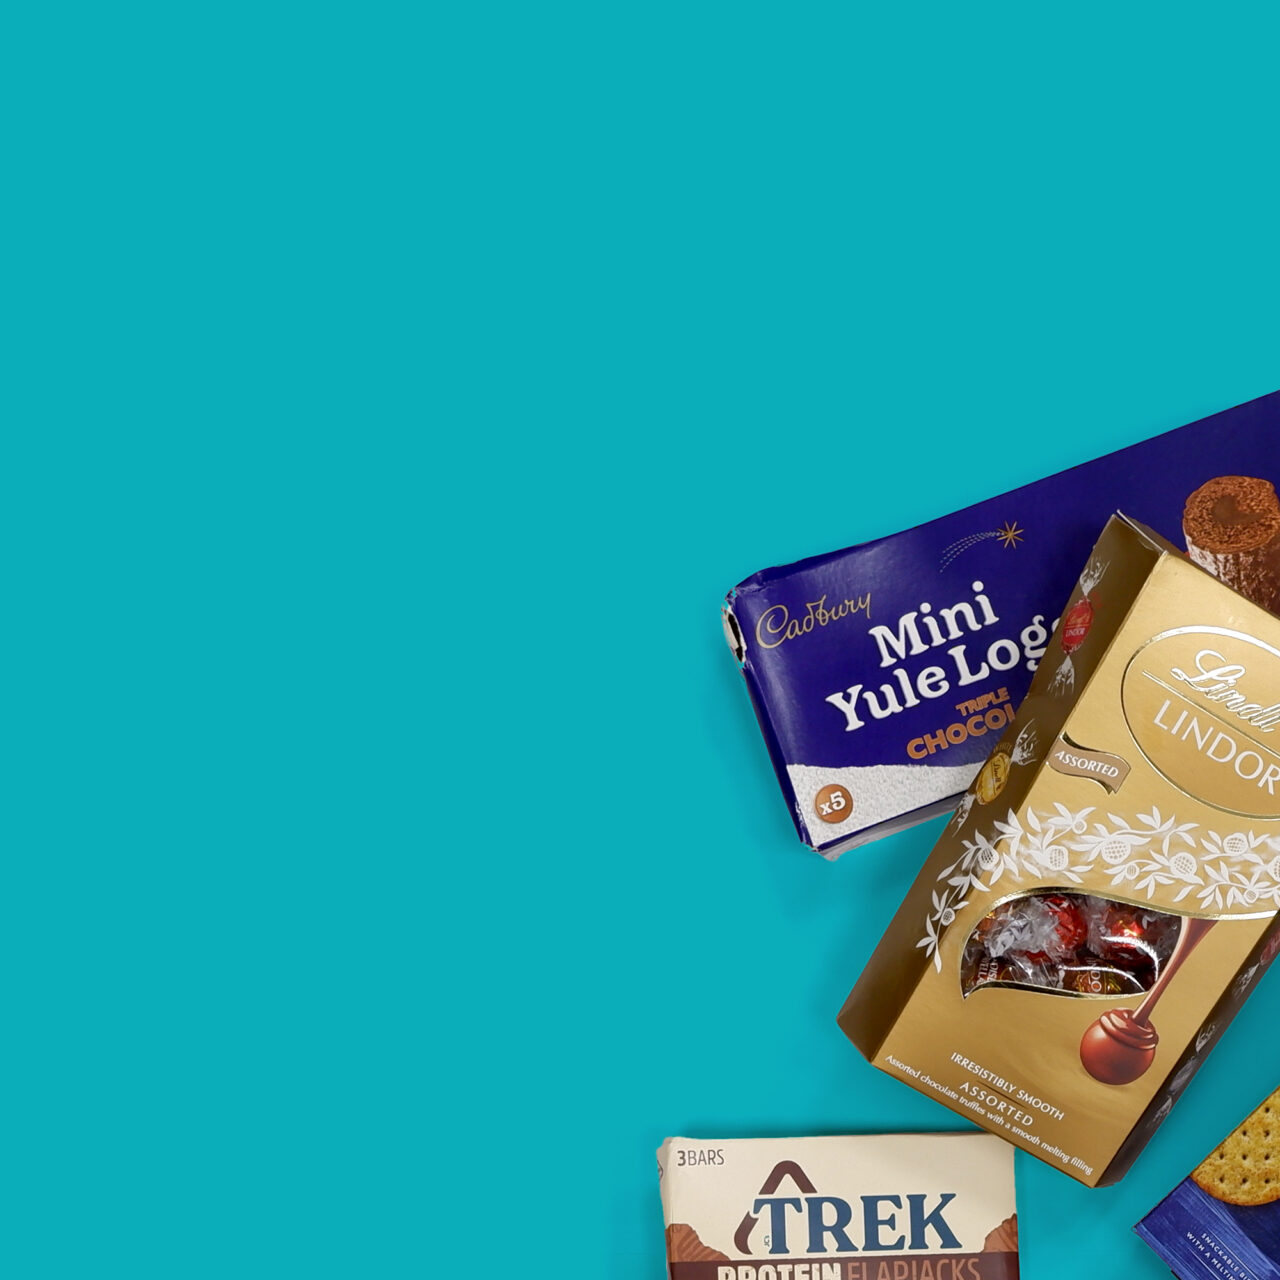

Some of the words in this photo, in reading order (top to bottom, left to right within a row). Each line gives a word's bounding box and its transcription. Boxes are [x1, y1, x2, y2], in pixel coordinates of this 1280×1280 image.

[756, 592, 872, 649] Cadbury
[868, 580, 999, 668] Mini
[825, 665, 950, 732] Yule
[948, 614, 1060, 687] Log
[955, 687, 1011, 717] TRIPLE
[1054, 750, 1119, 779] ASSORTED
[818, 790, 847, 818] x5
[951, 1052, 1017, 1094] IRRESISTIBLY
[1016, 1090, 1065, 1121] SMOOTH
[959, 1081, 1034, 1127] ASSORTED
[885, 1055, 921, 1079] Assorted
[919, 1074, 959, 1100] chocolate
[958, 1095, 986, 1115] truffles
[986, 1112, 1005, 1126] with
[1011, 1125, 1041, 1146] smooth
[1040, 1142, 1071, 1165] melting
[1069, 1157, 1094, 1176] filling
[752, 1193, 963, 1255] TREK
[1186, 1231, 1205, 1251] WITH
[1201, 1233, 1240, 1272] SNACKABLE
